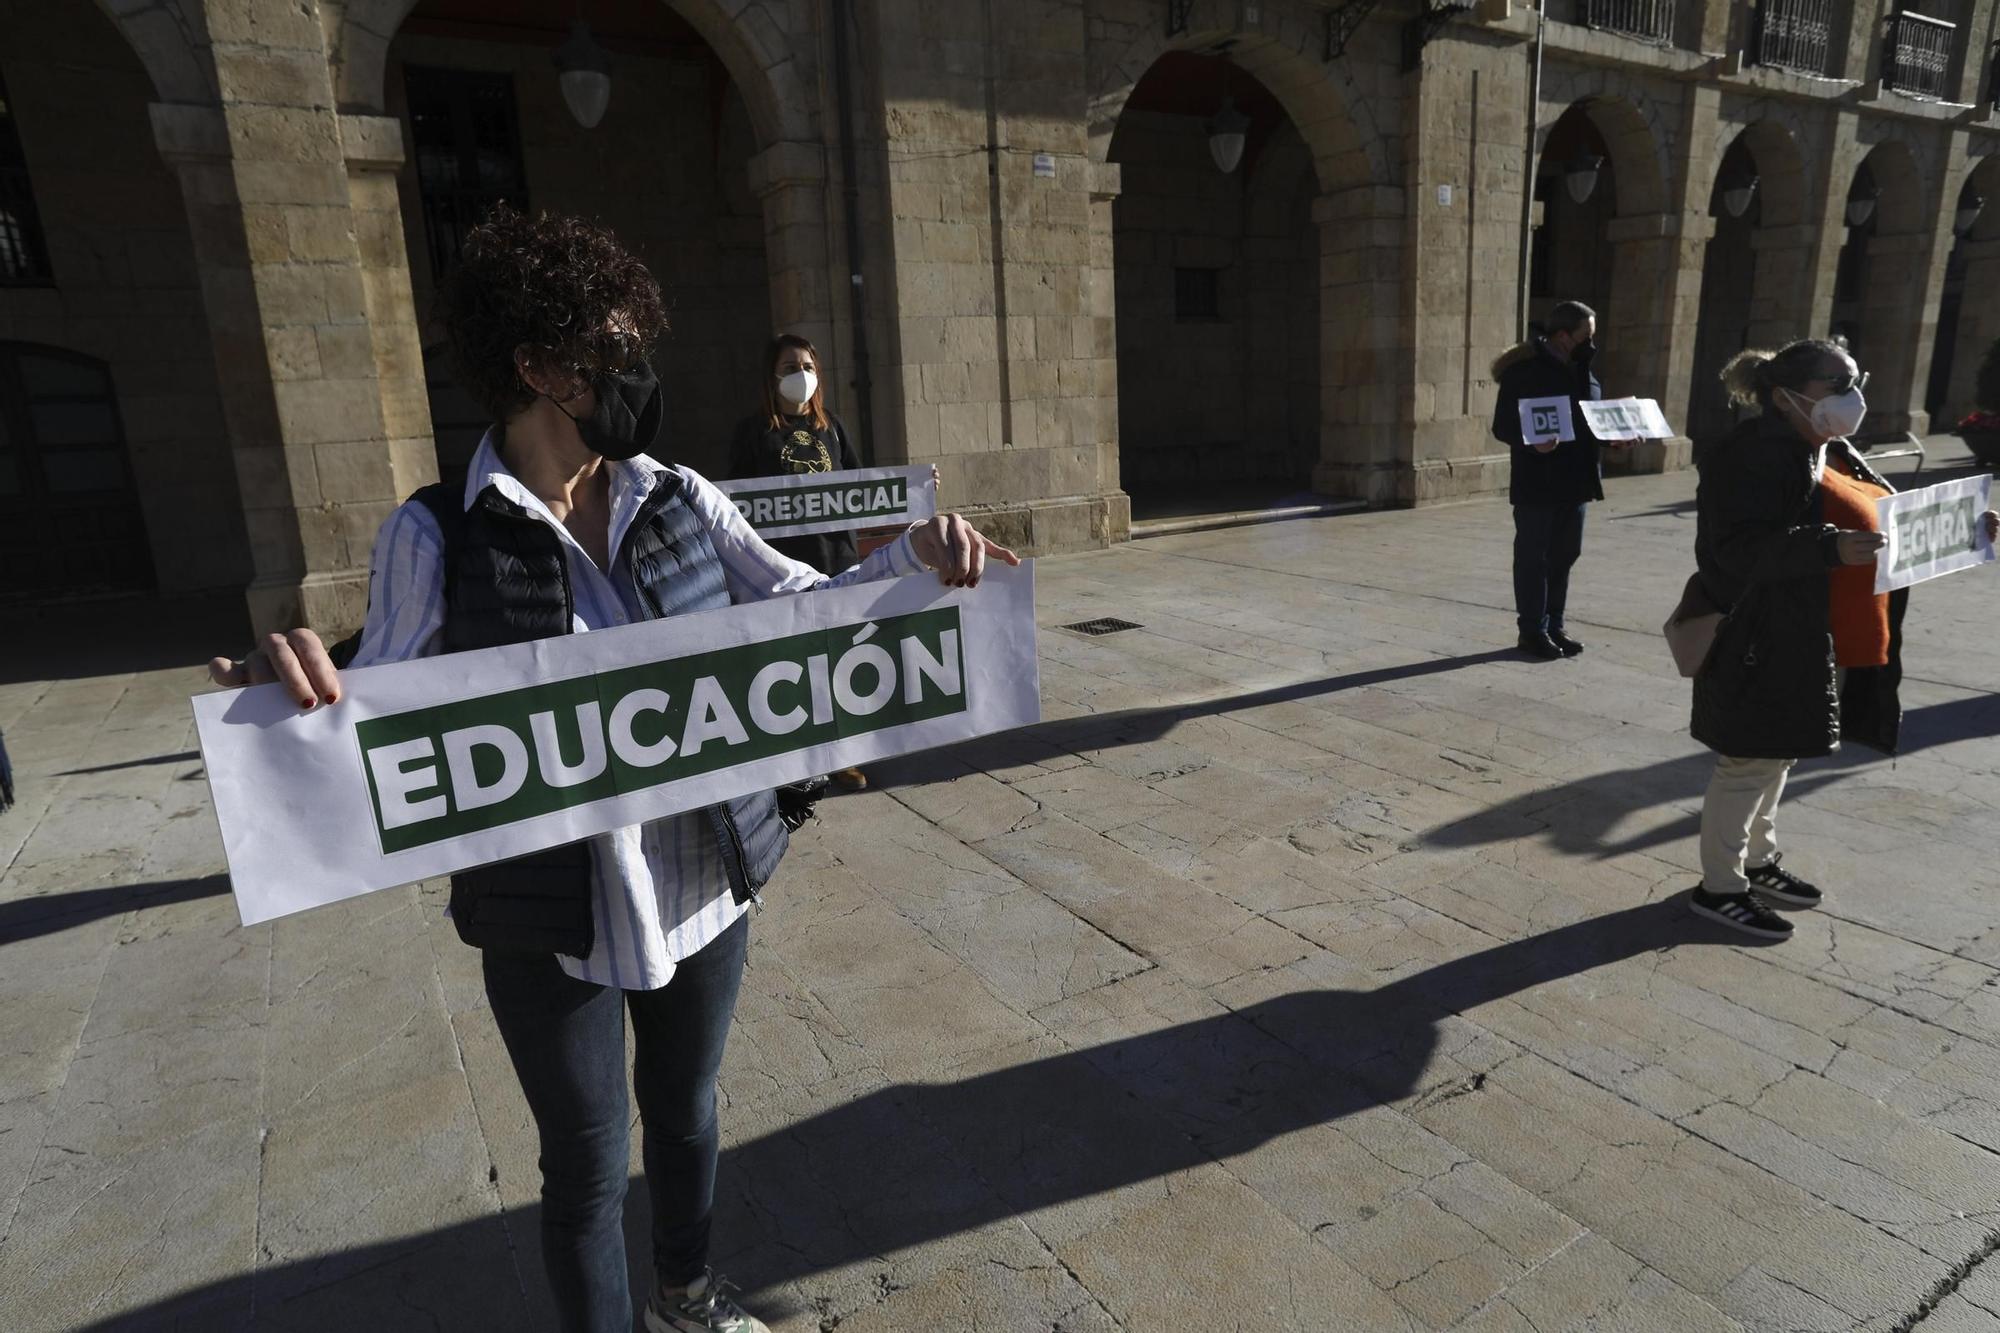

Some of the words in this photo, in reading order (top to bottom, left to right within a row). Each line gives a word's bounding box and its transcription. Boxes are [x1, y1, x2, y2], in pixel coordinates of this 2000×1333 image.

[1533, 412, 1559, 431] DE
[1897, 508, 1971, 561] EGURA
[367, 622, 961, 830] EDUCACIÓN
